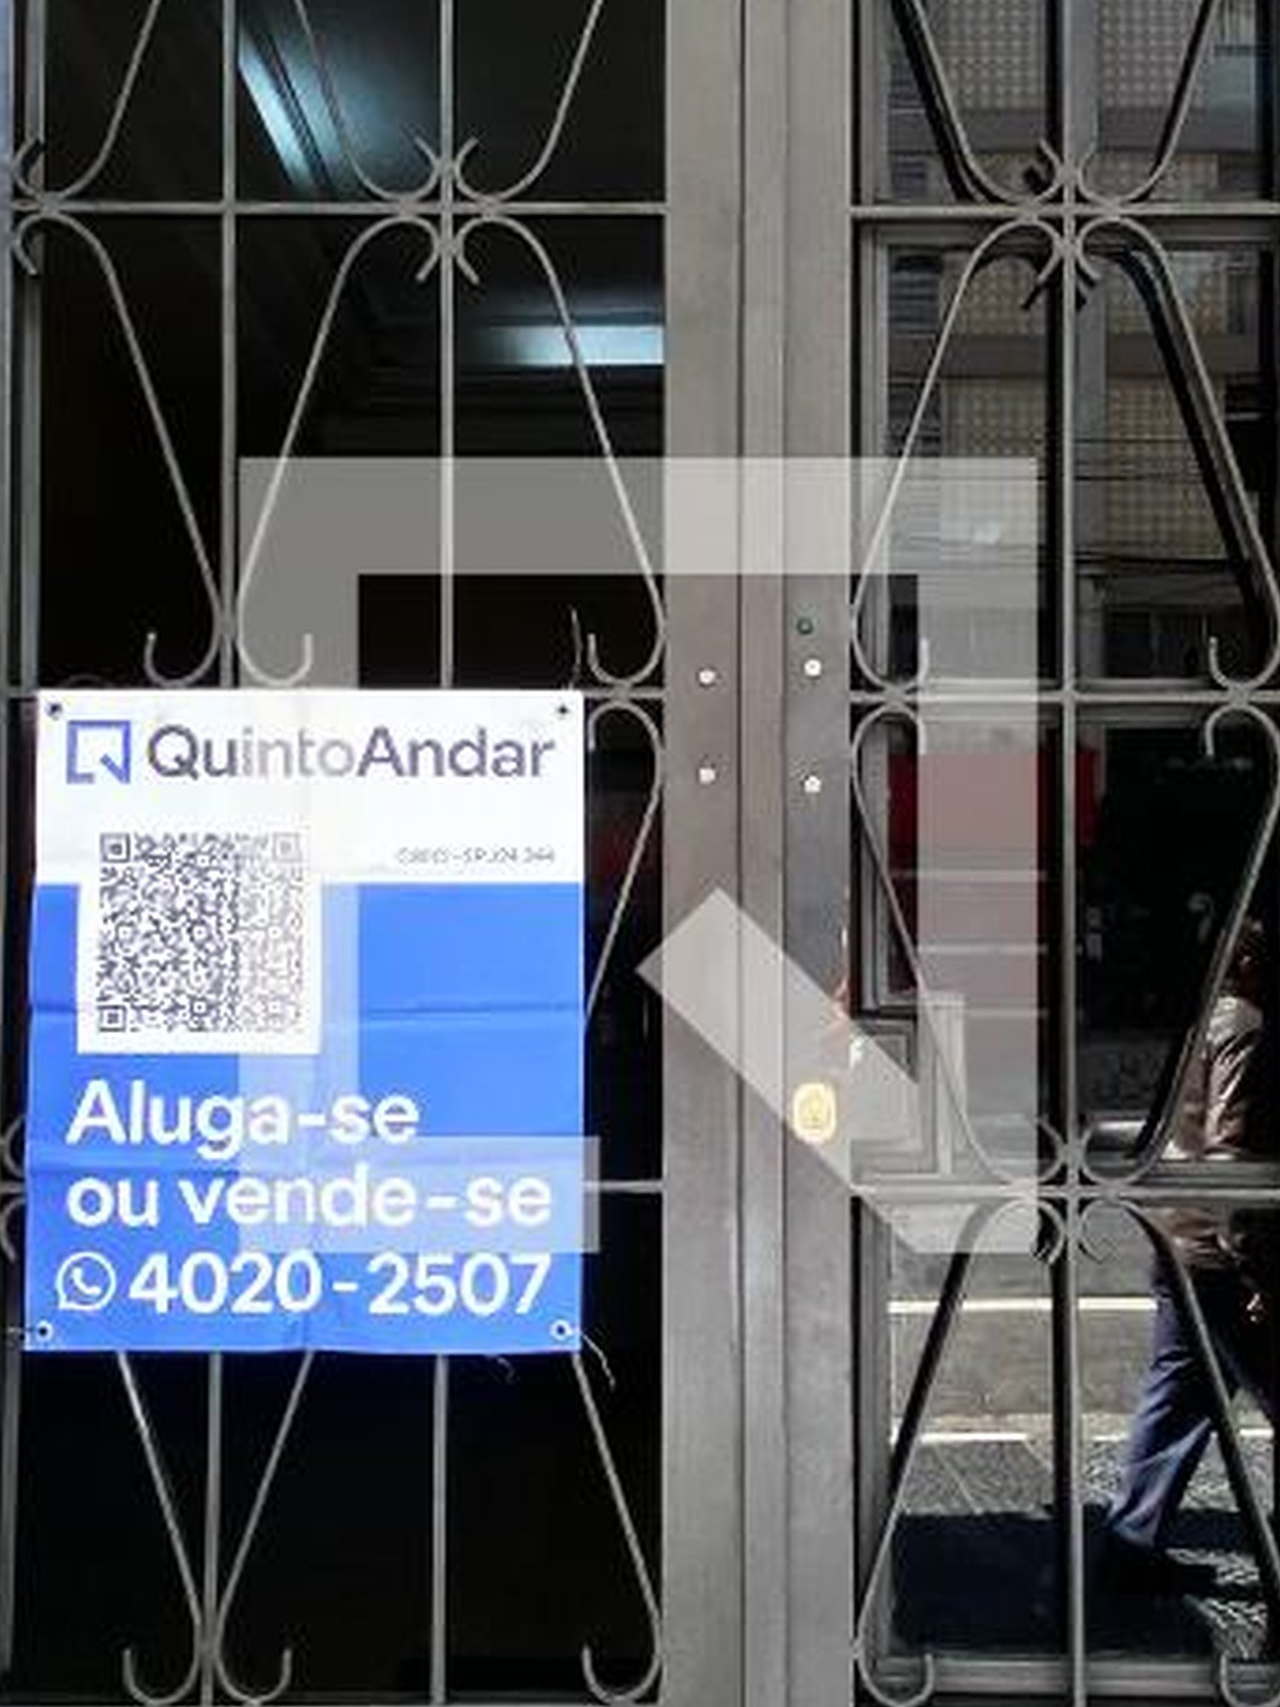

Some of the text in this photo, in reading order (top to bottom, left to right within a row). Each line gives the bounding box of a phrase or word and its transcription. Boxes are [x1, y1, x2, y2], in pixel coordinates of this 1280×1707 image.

[146, 723, 557, 782] QuintoAndar
[66, 1078, 421, 1161] Aluga-se
[66, 1162, 552, 1228] ou vende-se
[128, 1251, 553, 1316] 4020-2507
